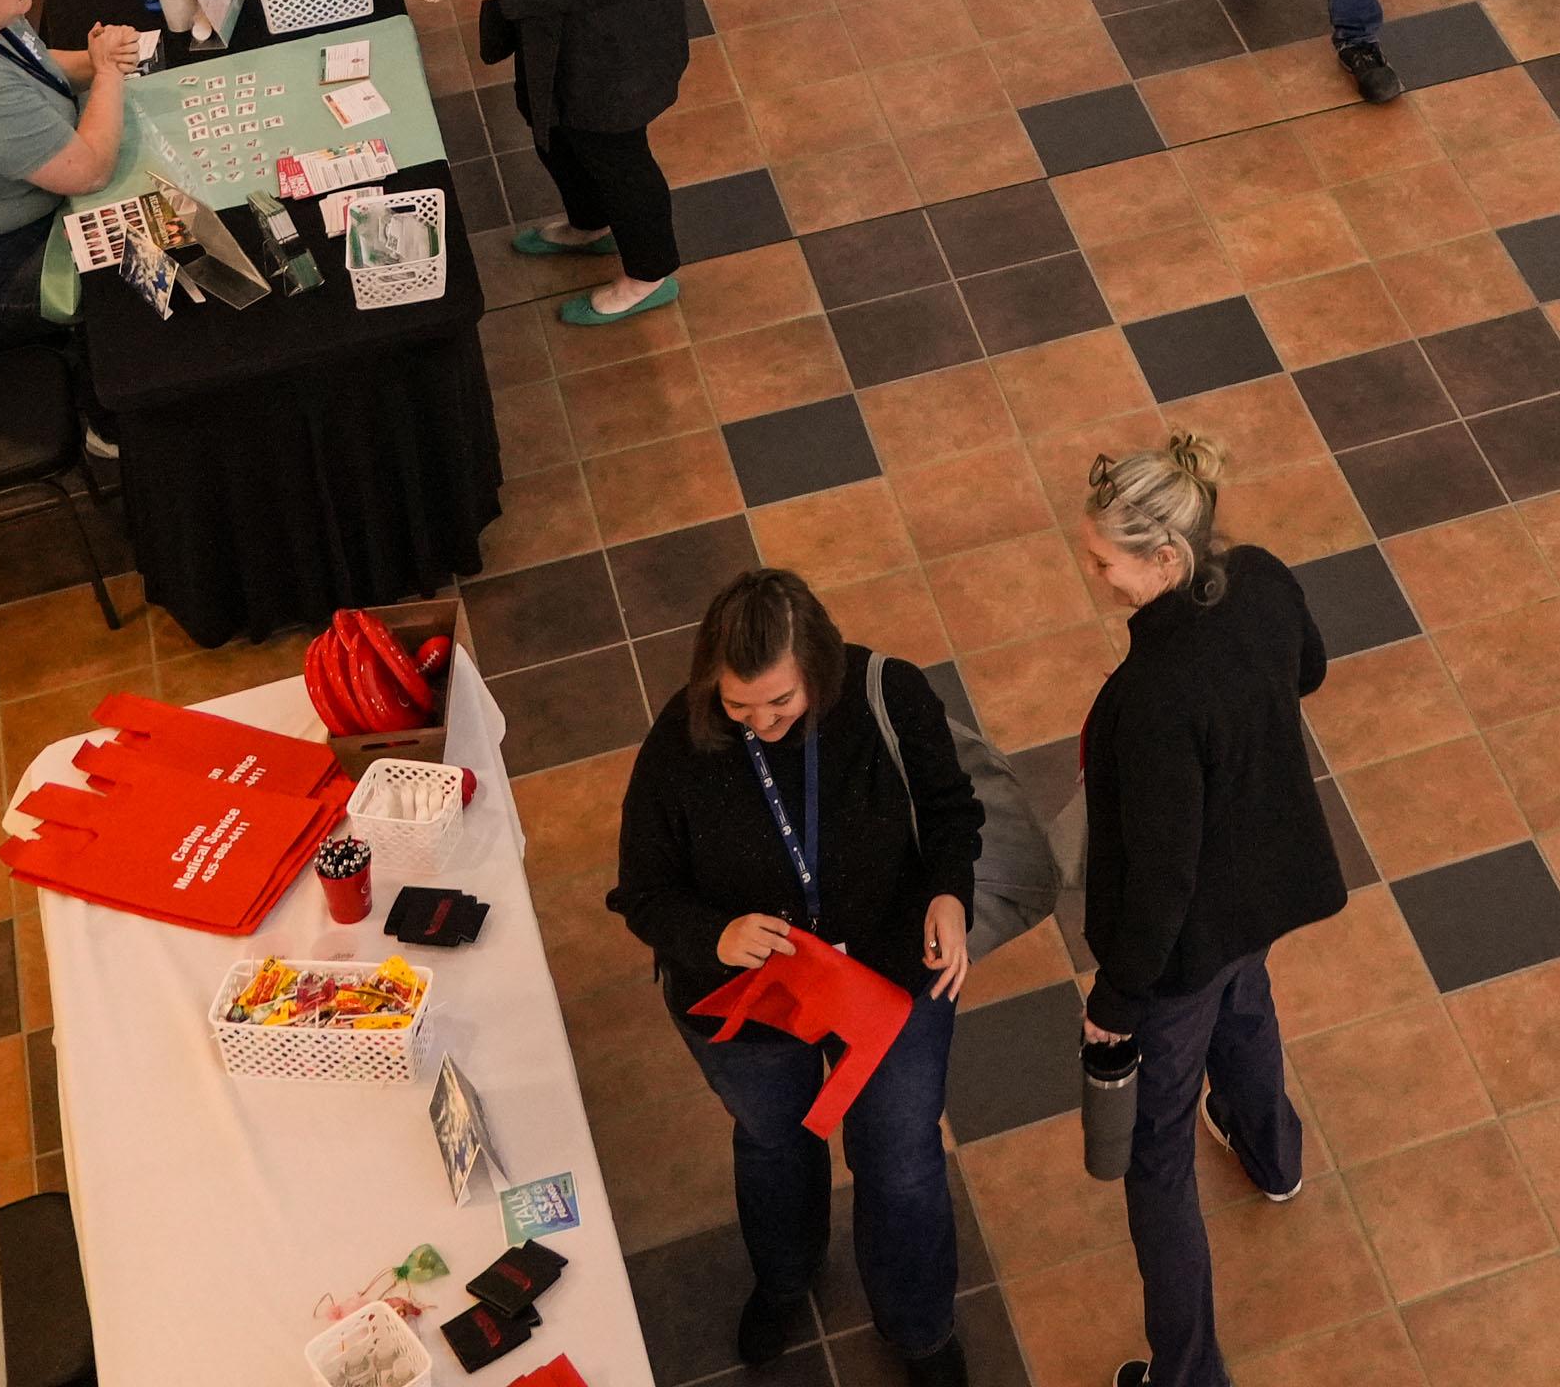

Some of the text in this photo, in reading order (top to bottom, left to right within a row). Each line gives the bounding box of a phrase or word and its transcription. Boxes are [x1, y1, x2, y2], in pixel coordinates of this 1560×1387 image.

[223, 755, 257, 784] ervice
[171, 825, 207, 862] Carbon
[173, 845, 211, 890] Medical
[203, 808, 241, 844] Service
[201, 821, 250, 883] 435-888-4411
